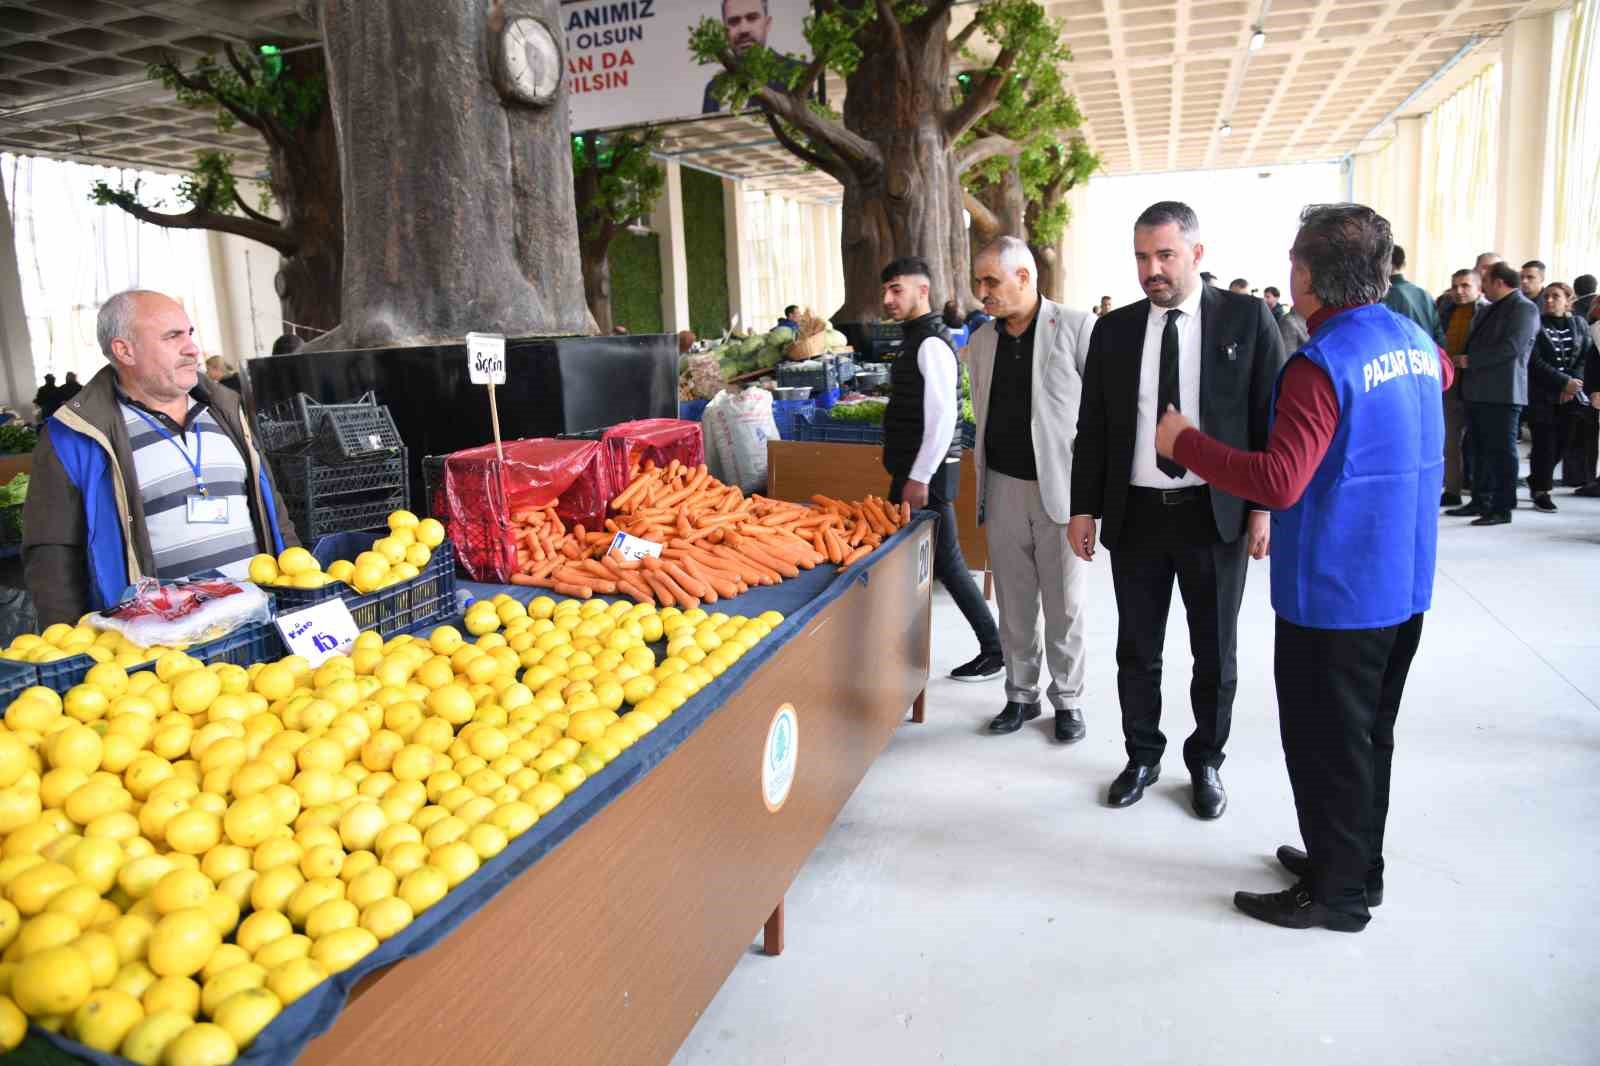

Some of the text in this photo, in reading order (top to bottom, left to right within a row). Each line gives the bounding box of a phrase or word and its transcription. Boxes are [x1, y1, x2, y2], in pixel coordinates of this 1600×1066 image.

[565, 0, 655, 31] ANIMIZ
[576, 24, 643, 49] OLSUN
[601, 48, 635, 70] DA
[1363, 349, 1408, 393] PAZAR
